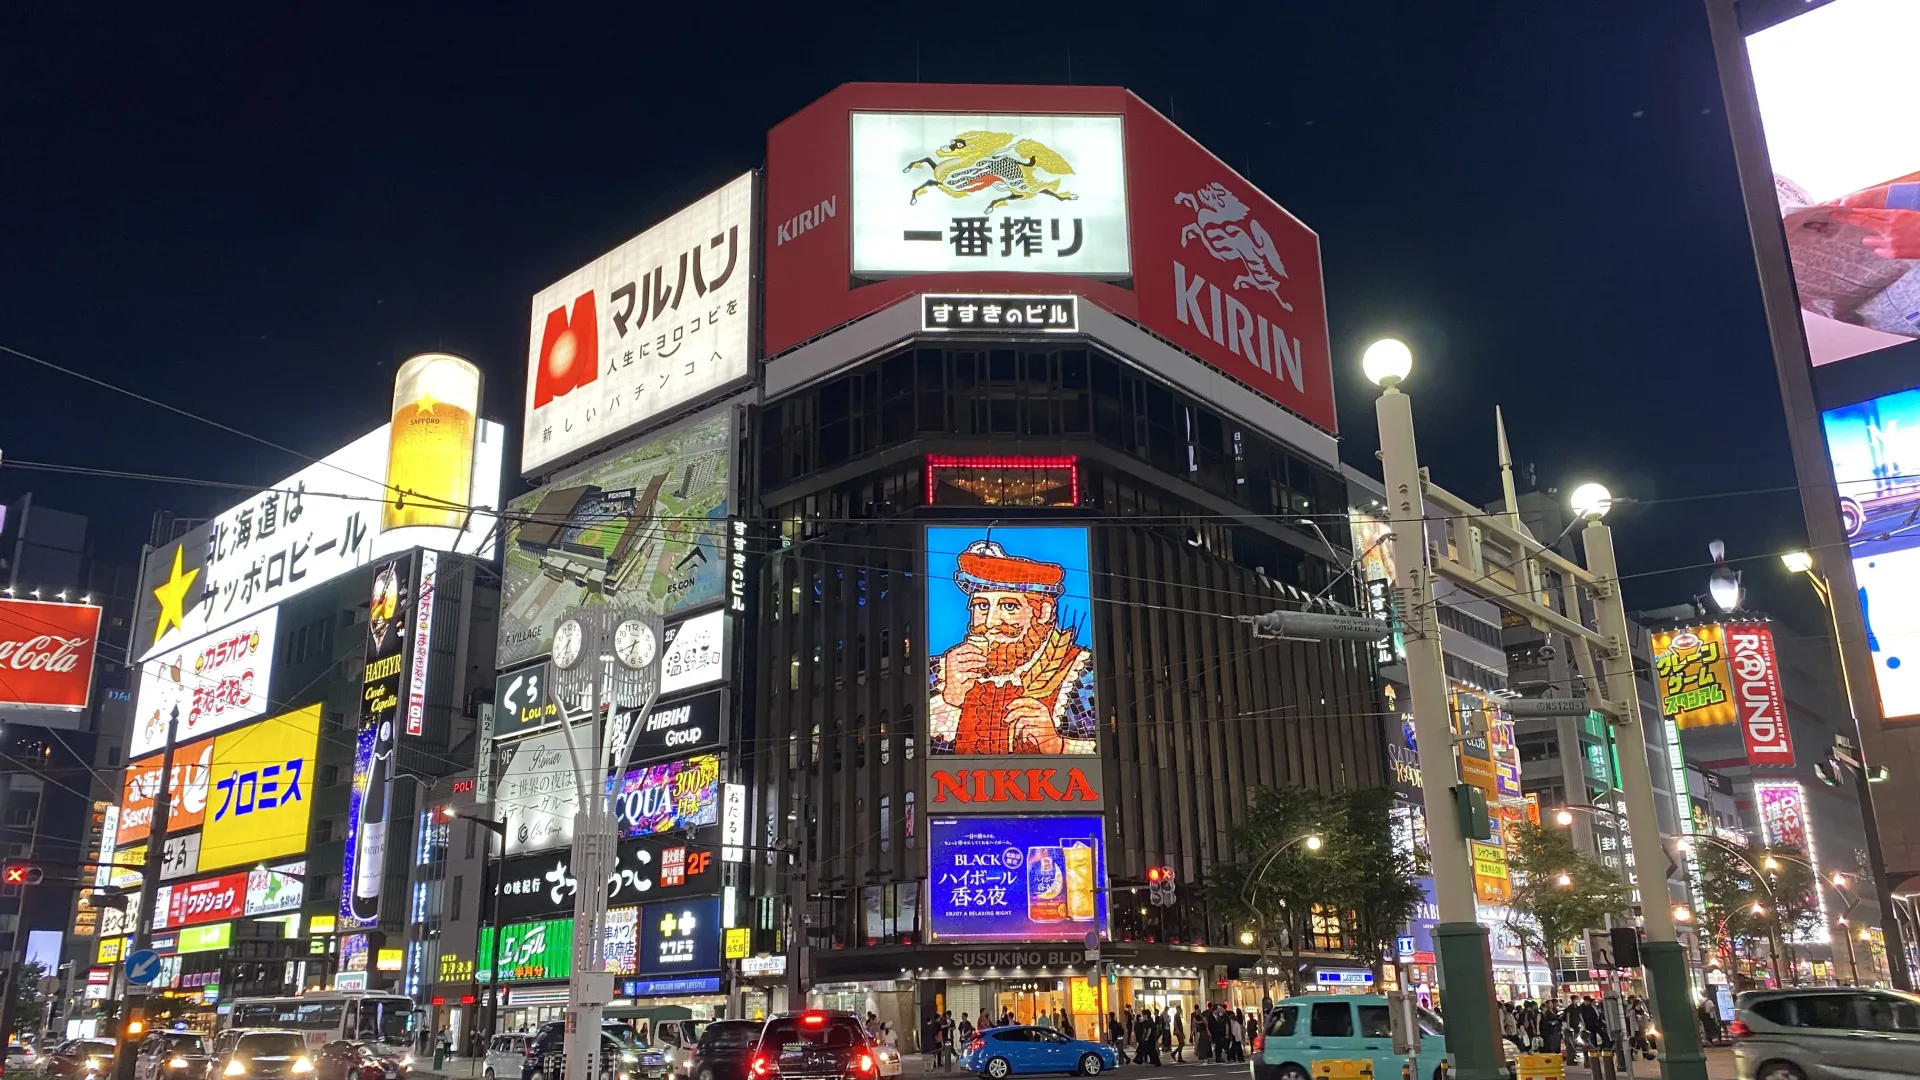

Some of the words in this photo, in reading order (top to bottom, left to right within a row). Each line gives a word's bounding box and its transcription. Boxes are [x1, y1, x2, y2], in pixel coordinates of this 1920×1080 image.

[777, 195, 836, 246] KIRIN
[903, 216, 1083, 257] 一番搾り
[610, 224, 738, 339] マルハン
[933, 304, 1067, 323] すすきのビル
[1173, 260, 1304, 394] KIRIN
[607, 299, 738, 376] 人生にヨロコビを
[542, 351, 722, 443] 新しいパチンコへ
[410, 417, 441, 426] SAPPORO
[607, 490, 631, 501] FIGHTERS
[204, 479, 305, 568] 北海道は
[202, 512, 368, 625] サッポロビール
[678, 577, 696, 591] CON
[513, 625, 543, 644] VILLAGE
[619, 630, 627, 638] 10
[625, 624, 631, 632] 11
[632, 623, 639, 631] 12
[664, 629, 676, 642] 2F
[1370, 583, 1393, 663] すすきビル
[203, 632, 251, 671] カラオケ
[638, 656, 643, 664] 5
[1657, 642, 1718, 677] クレーン
[1668, 666, 1714, 694] ゲーム
[188, 669, 255, 728] まねきねこ
[1664, 684, 1724, 716] スタジアム
[1766, 669, 1786, 739] ENTERTAINMENT
[646, 705, 691, 732] HIBIKI
[665, 727, 702, 747] Group
[214, 757, 304, 823] プロミス
[931, 767, 1099, 804] NIKKA
[163, 838, 188, 871] 牛角
[687, 851, 711, 875] 2F
[954, 854, 1001, 866] BLACK
[938, 869, 1017, 886] ハイボール
[187, 887, 235, 915] ワタショウ
[950, 886, 1008, 907] 香る夜
[952, 952, 1041, 966] SUSUKINO
[1048, 951, 1087, 965] BLD.
